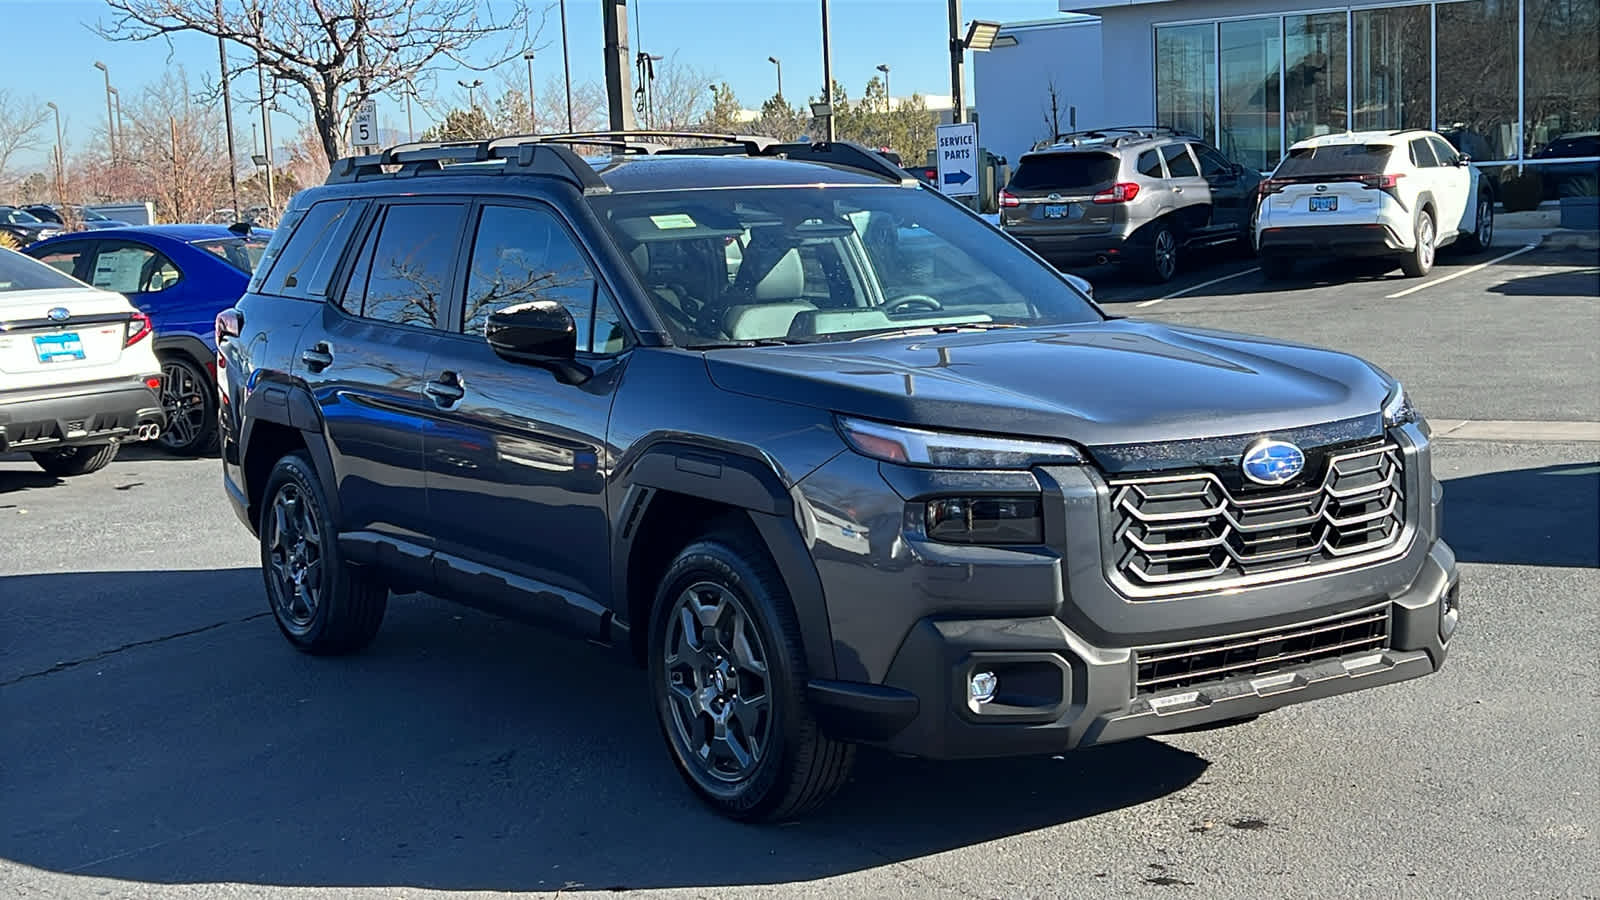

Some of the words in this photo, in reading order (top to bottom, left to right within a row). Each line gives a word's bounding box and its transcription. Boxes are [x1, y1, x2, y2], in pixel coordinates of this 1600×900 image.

[355, 115, 370, 123] LIMIT
[359, 124, 369, 140] 5
[940, 136, 973, 147] SERVICE
[944, 149, 970, 160] PARTS
